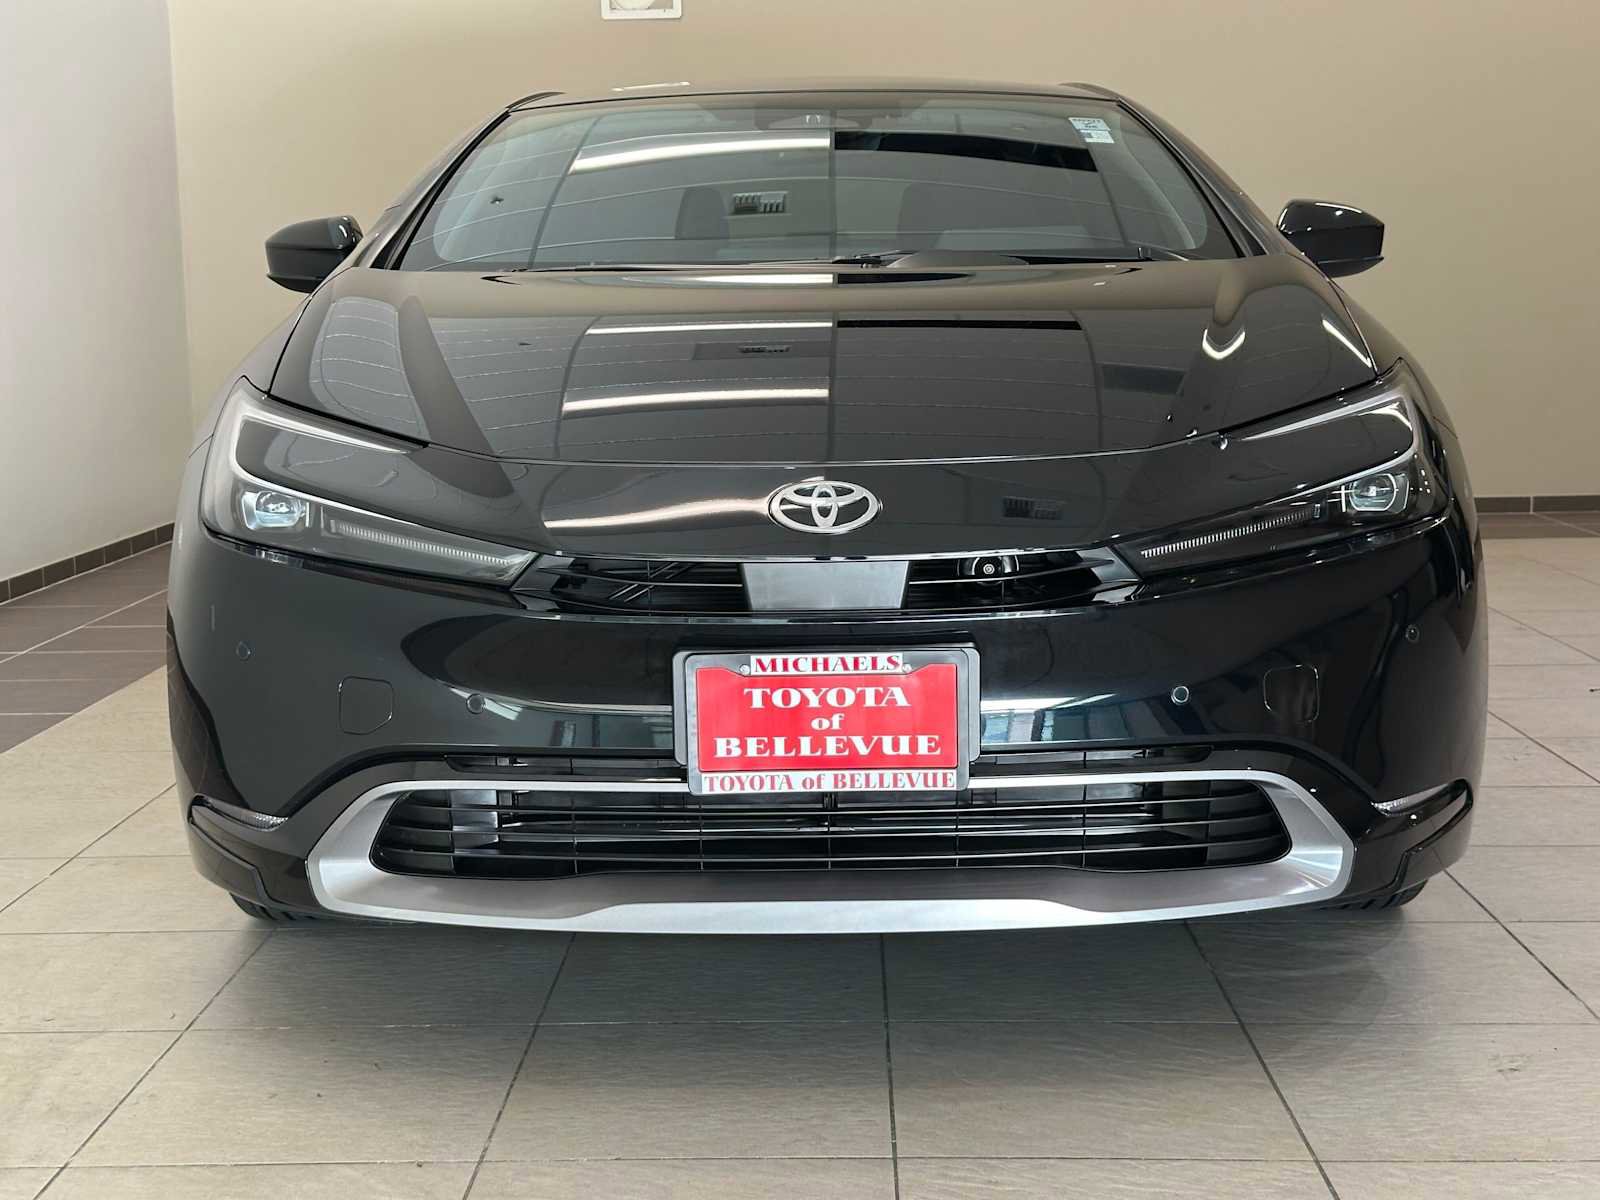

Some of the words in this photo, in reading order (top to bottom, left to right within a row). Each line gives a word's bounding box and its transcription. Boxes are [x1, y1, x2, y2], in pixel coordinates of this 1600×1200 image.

[754, 655, 902, 673] MICHAELS
[744, 686, 912, 709] TOYOTA
[811, 713, 844, 731] of
[713, 735, 941, 758] BELLEVUE
[704, 774, 793, 792] TOYOTA
[801, 773, 826, 790] of
[833, 772, 955, 790] BELLEVUE
